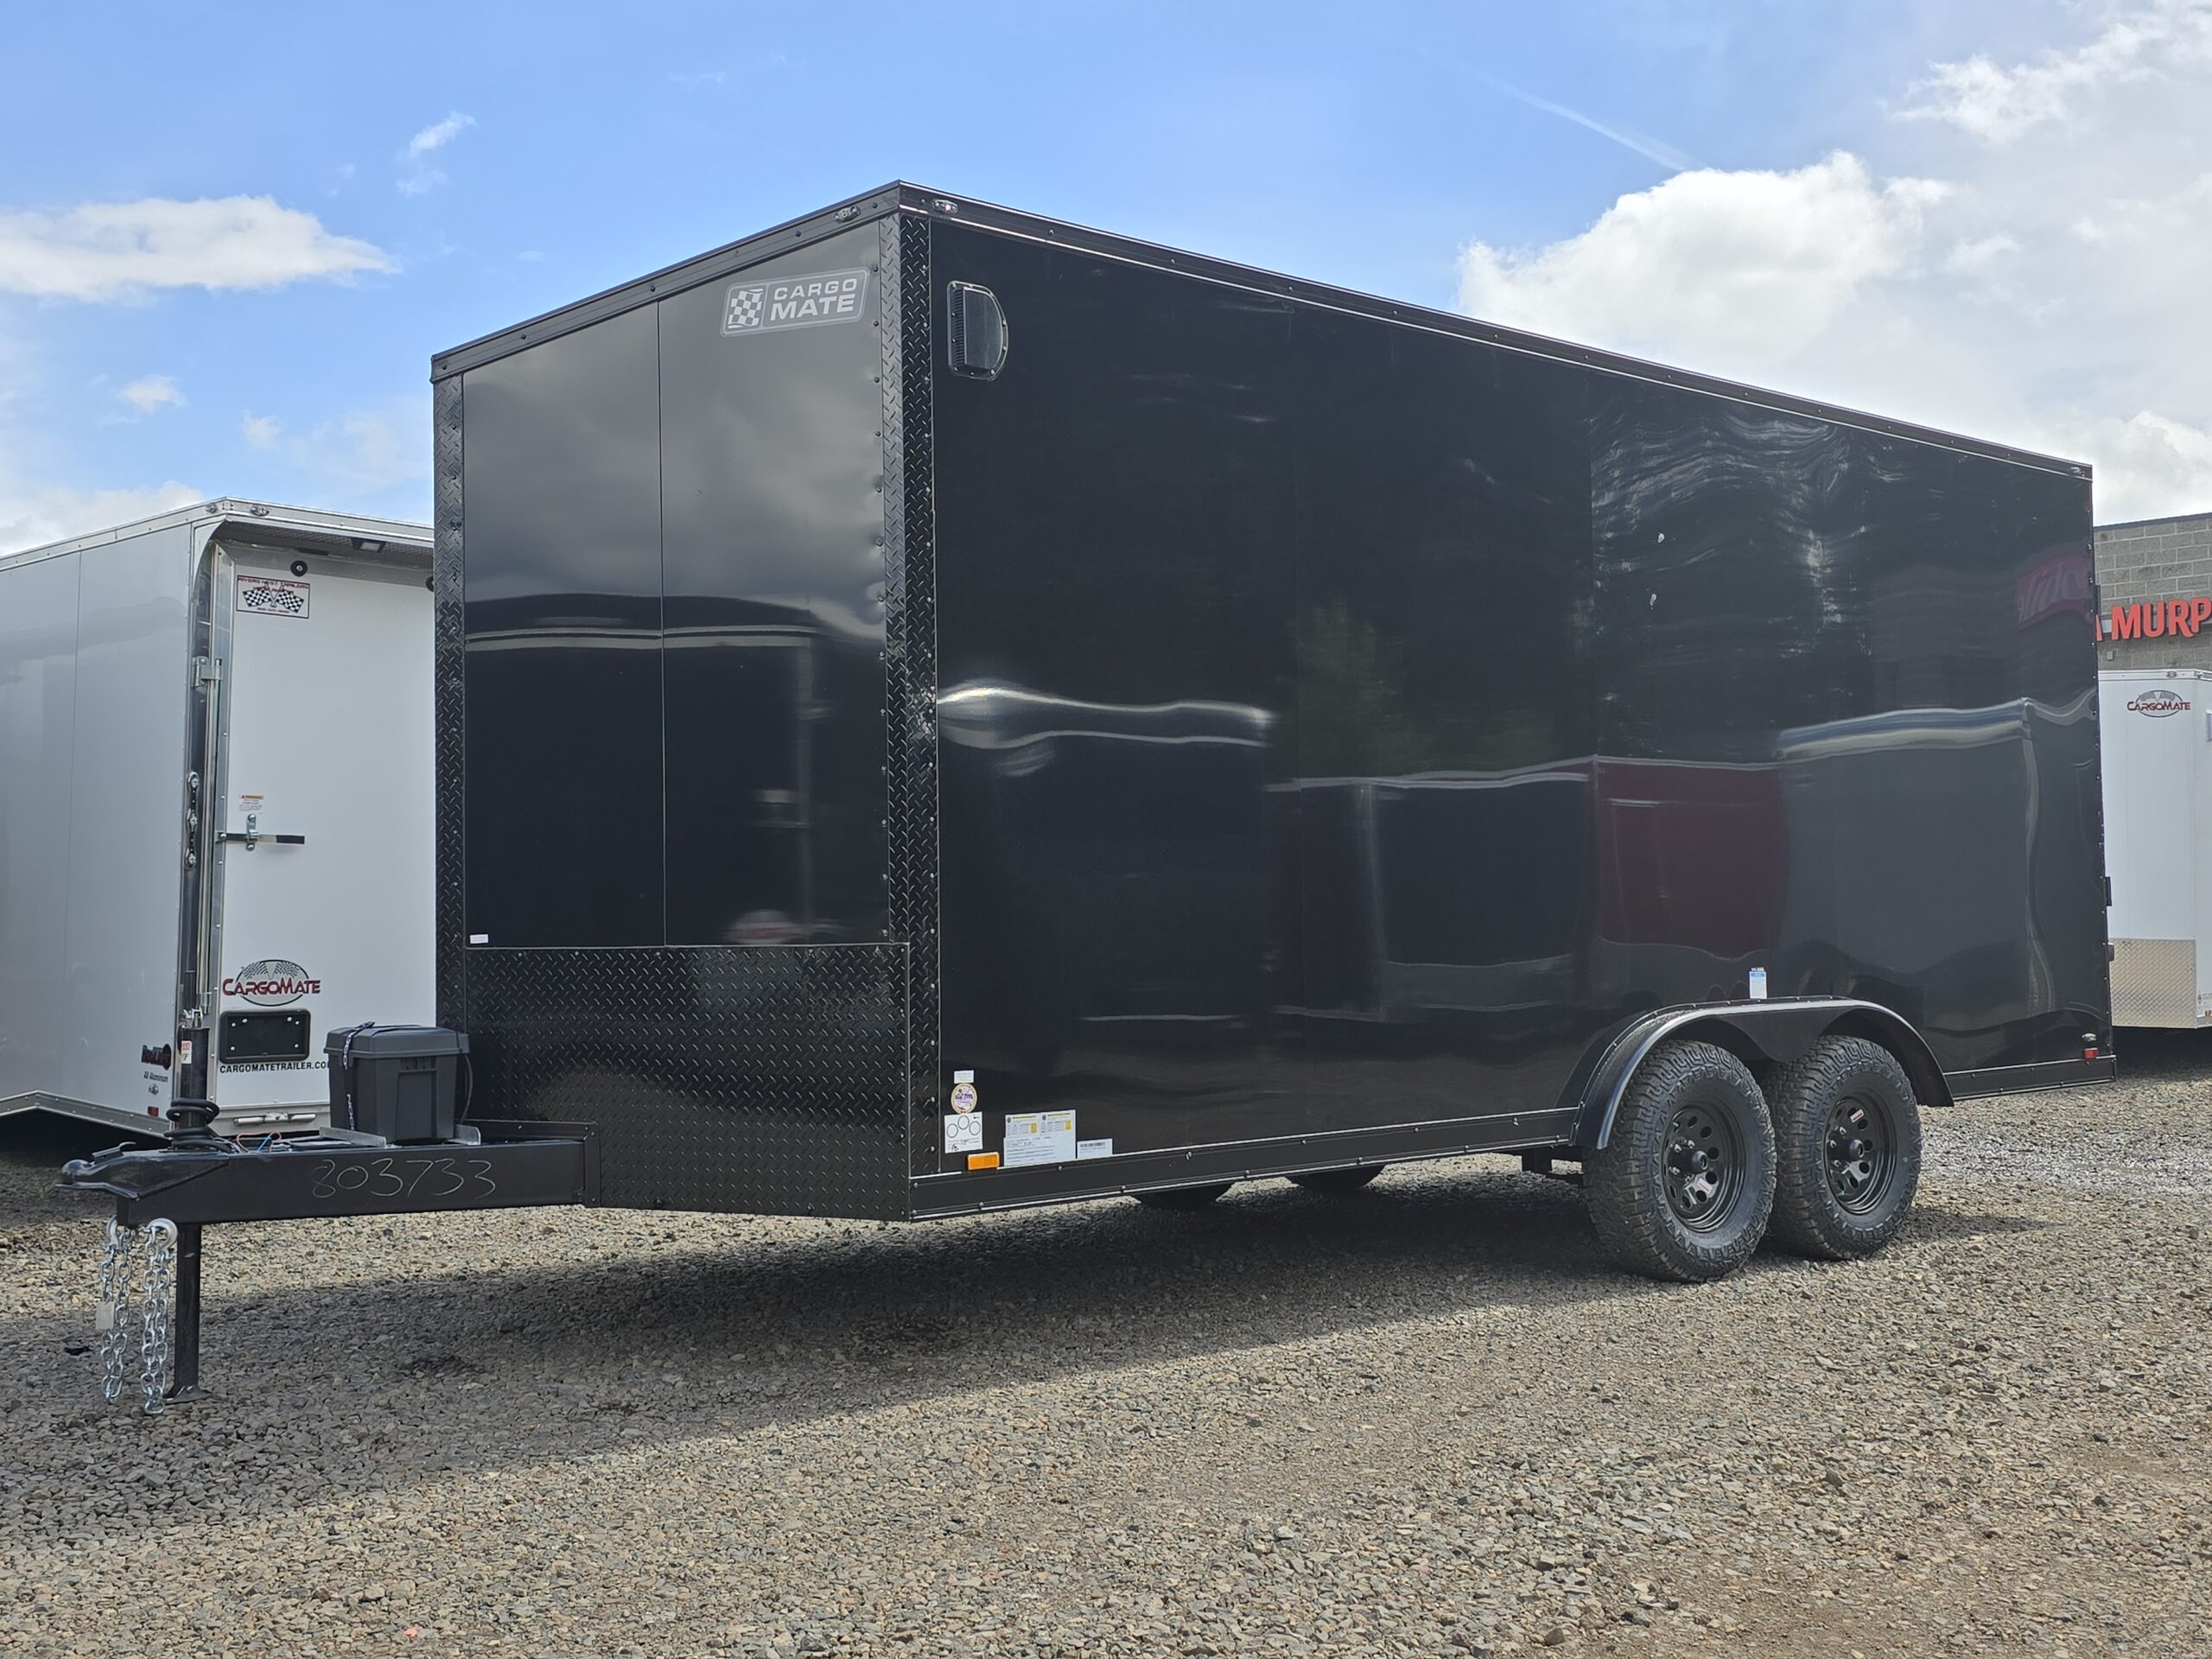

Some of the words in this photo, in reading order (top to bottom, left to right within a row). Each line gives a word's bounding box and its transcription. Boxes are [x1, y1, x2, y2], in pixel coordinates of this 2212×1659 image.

[773, 277, 858, 301] CARGO
[770, 293, 855, 321] MATE
[2111, 596, 2212, 641] MURP
[312, 1157, 496, 1199] 803733
